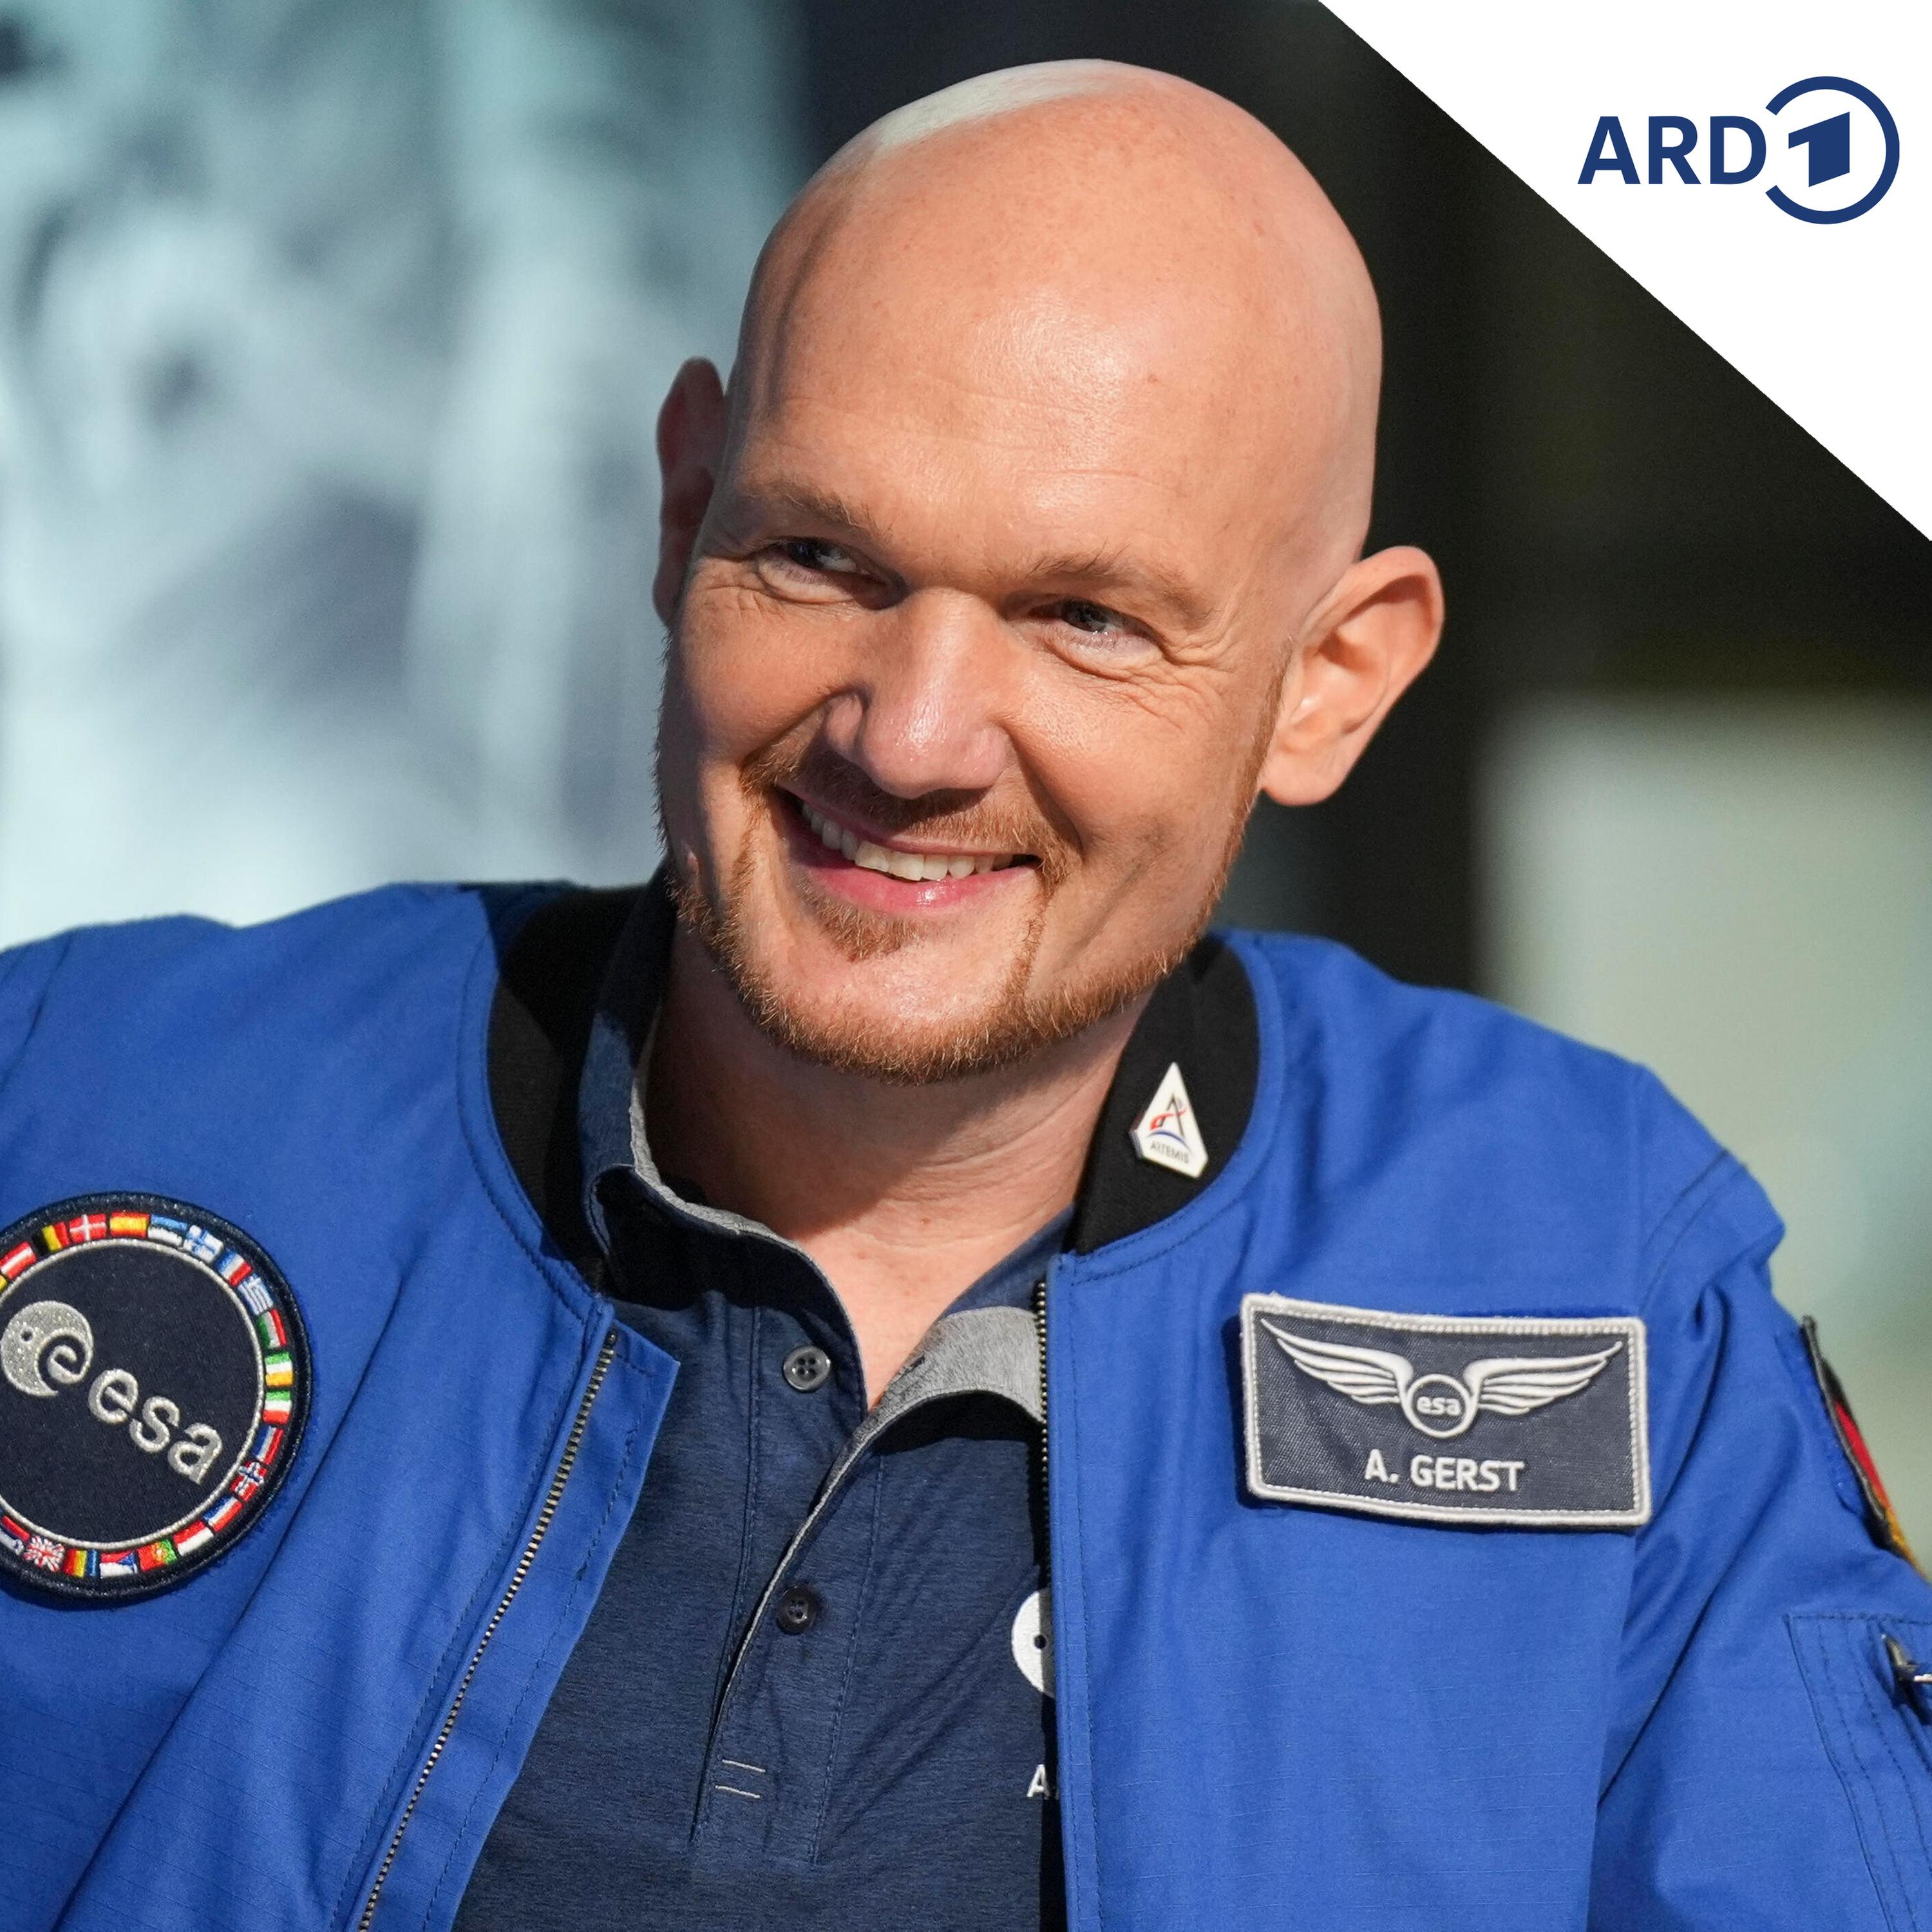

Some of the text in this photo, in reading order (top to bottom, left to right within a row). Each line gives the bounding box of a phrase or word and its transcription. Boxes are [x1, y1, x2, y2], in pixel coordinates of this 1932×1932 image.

[89, 1368, 223, 1484] esa
[1417, 1396, 1461, 1416] esa
[1364, 1448, 1524, 1492] A. GERST
